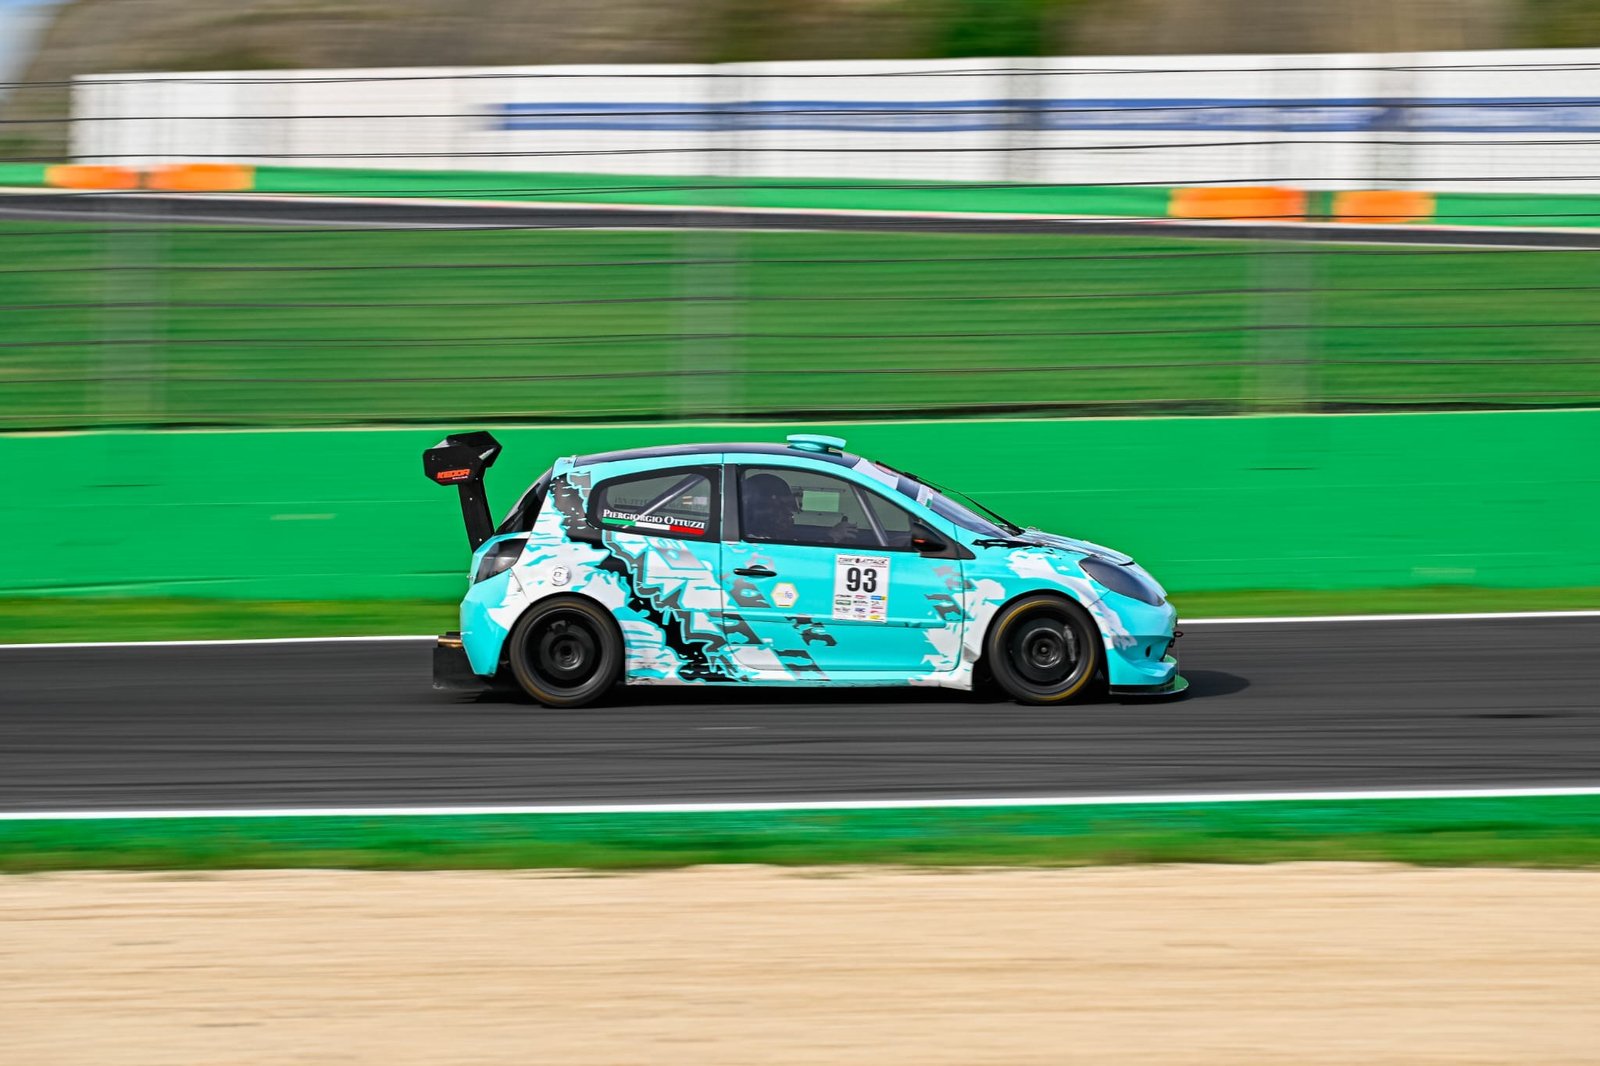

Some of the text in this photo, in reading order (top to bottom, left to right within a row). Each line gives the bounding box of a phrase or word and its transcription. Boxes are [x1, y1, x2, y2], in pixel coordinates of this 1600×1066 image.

[602, 509, 705, 529] PIERGIORGIO OTTUZZI
[846, 567, 877, 593] 93
